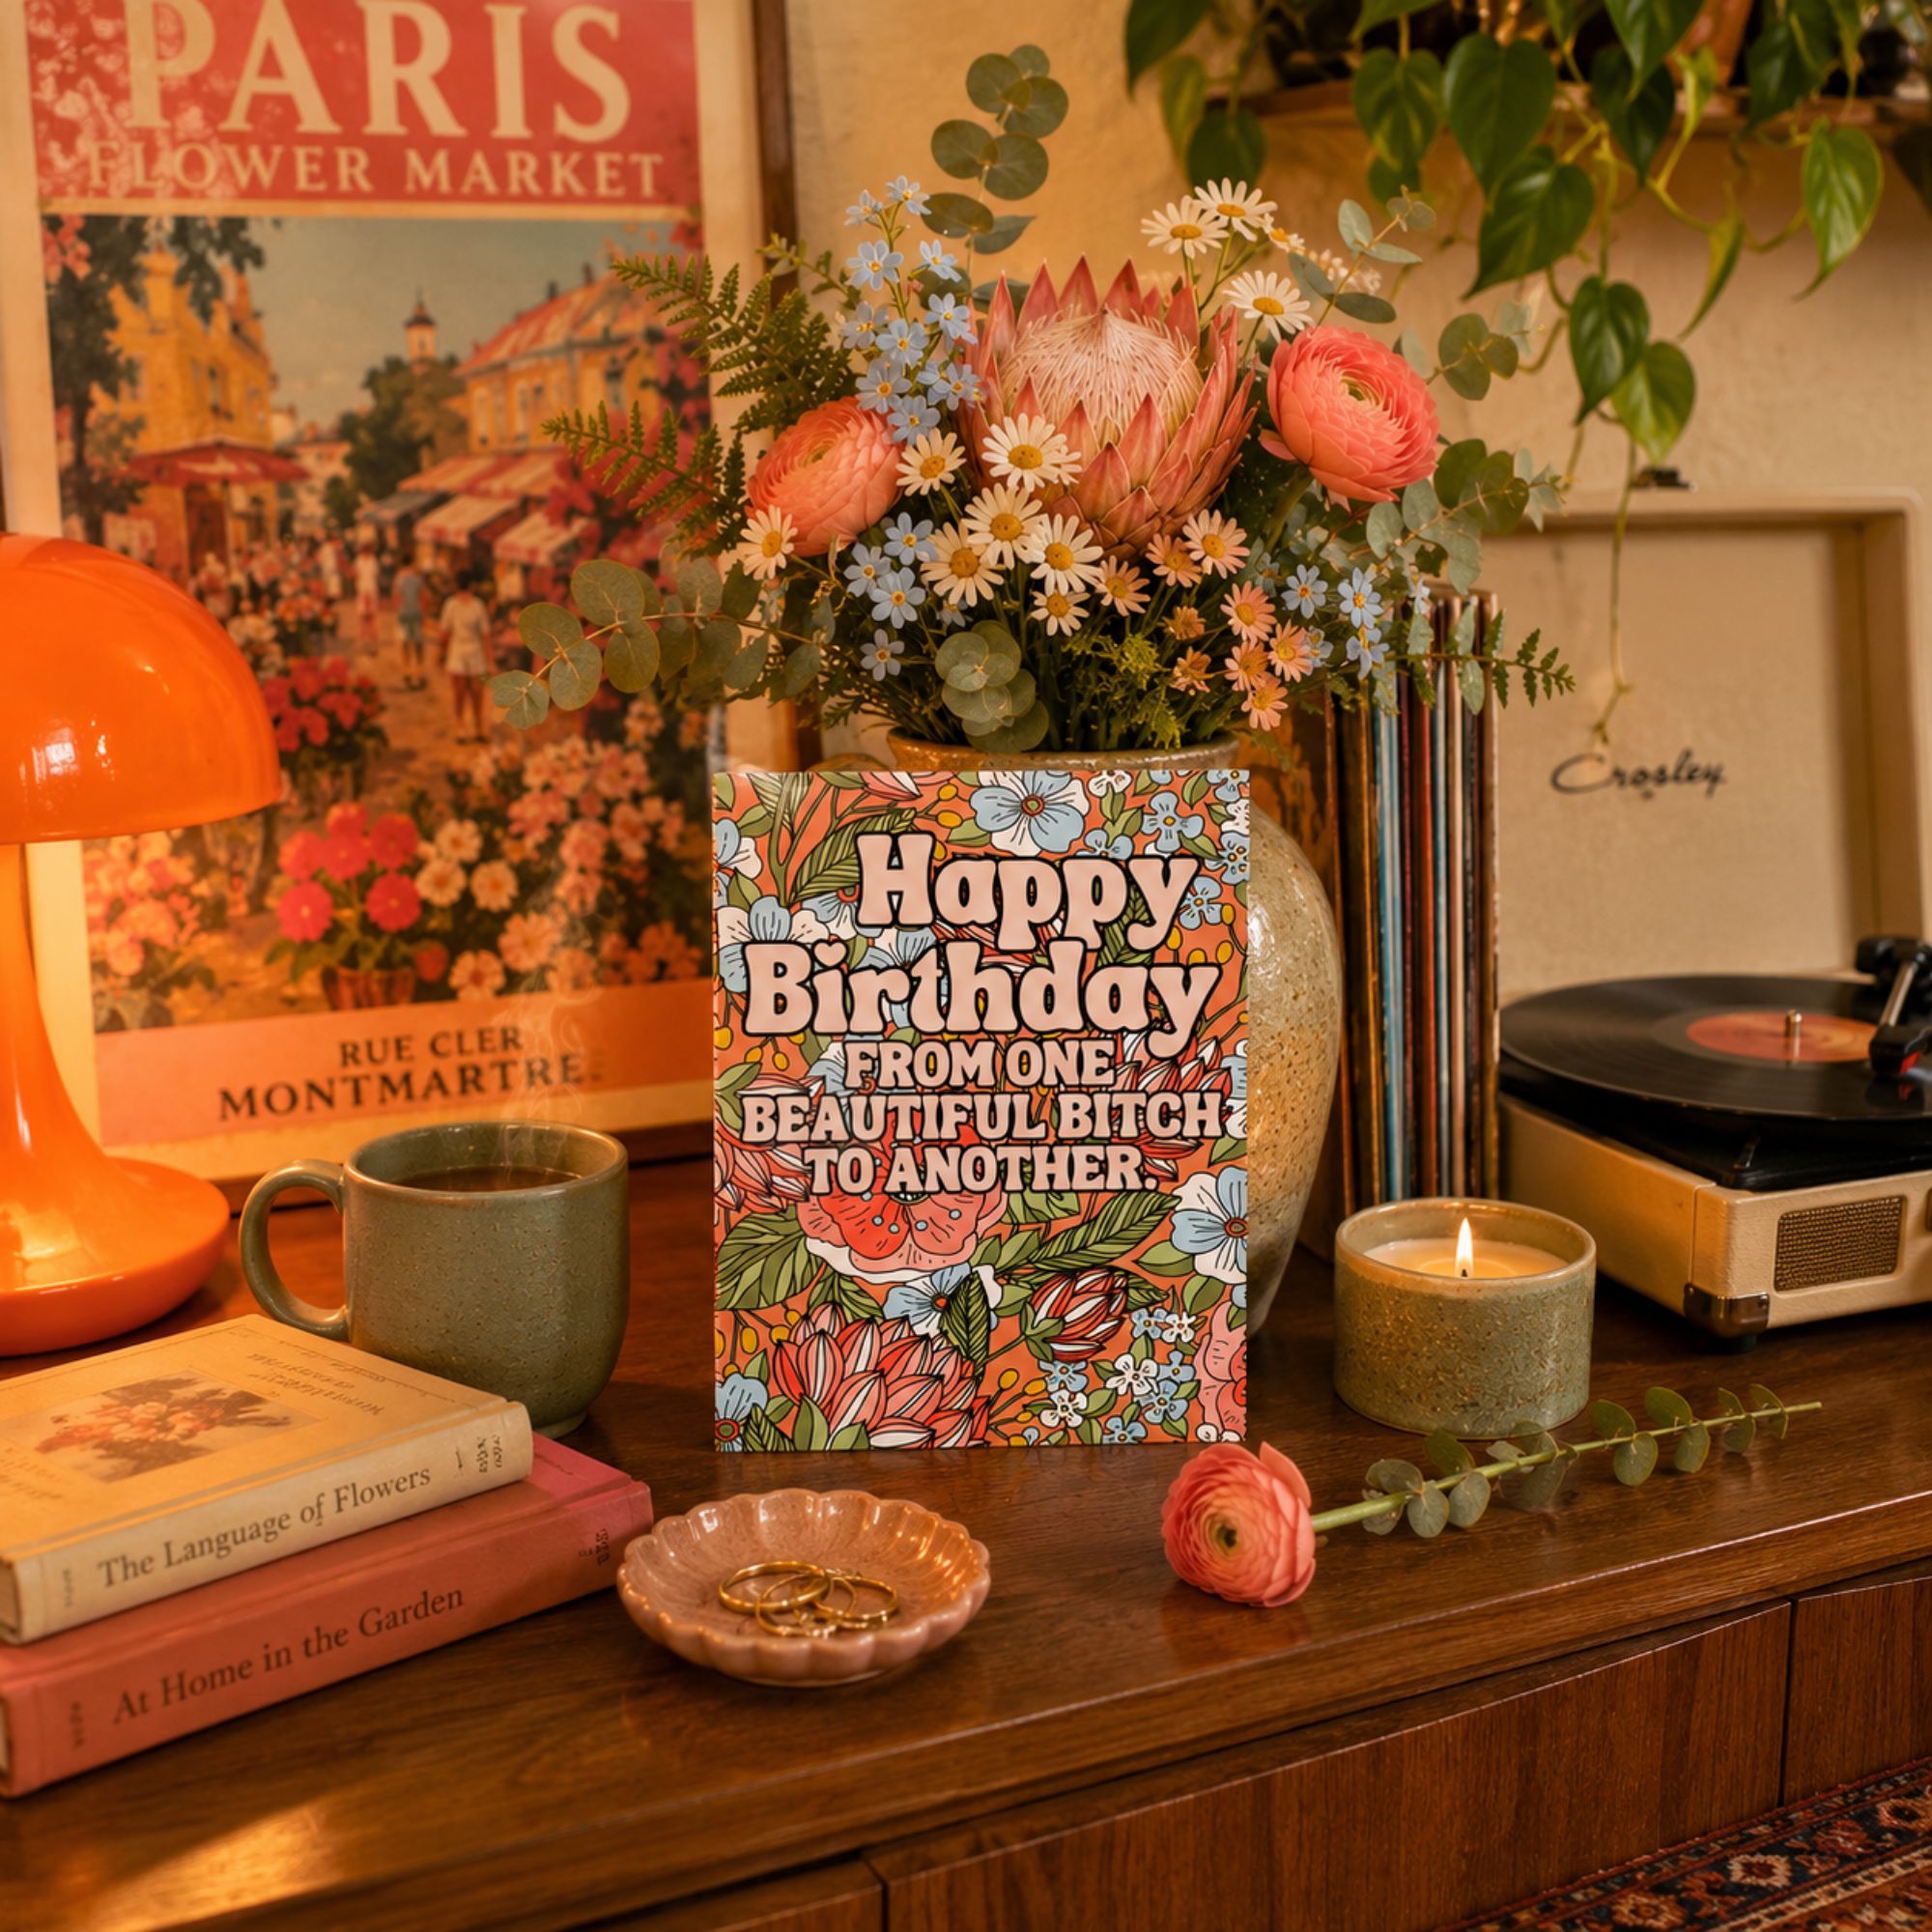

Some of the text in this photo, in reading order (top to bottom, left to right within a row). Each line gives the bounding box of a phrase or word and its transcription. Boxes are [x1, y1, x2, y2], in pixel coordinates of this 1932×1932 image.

[123, 0, 631, 143] PARIS
[89, 141, 665, 197] FLOWER MARKET
[1550, 747, 1726, 799] Crosley
[855, 832, 1200, 952] Happy
[742, 937, 1224, 1059] Birthday
[339, 1026, 523, 1068] RUE CLER
[842, 1038, 1117, 1088] FROM ONE
[740, 1090, 1228, 1142] BEAUTIFUL BITCH
[802, 1144, 1159, 1194] TO ANOTHER.
[99, 1553, 155, 1589] The
[163, 1513, 292, 1576] Language
[299, 1494, 325, 1526] of
[333, 1467, 432, 1515] Flowers
[112, 1691, 151, 1725] At
[159, 1657, 253, 1707] Home
[263, 1643, 293, 1673] in
[302, 1623, 350, 1661] the
[358, 1585, 465, 1639] Garden
